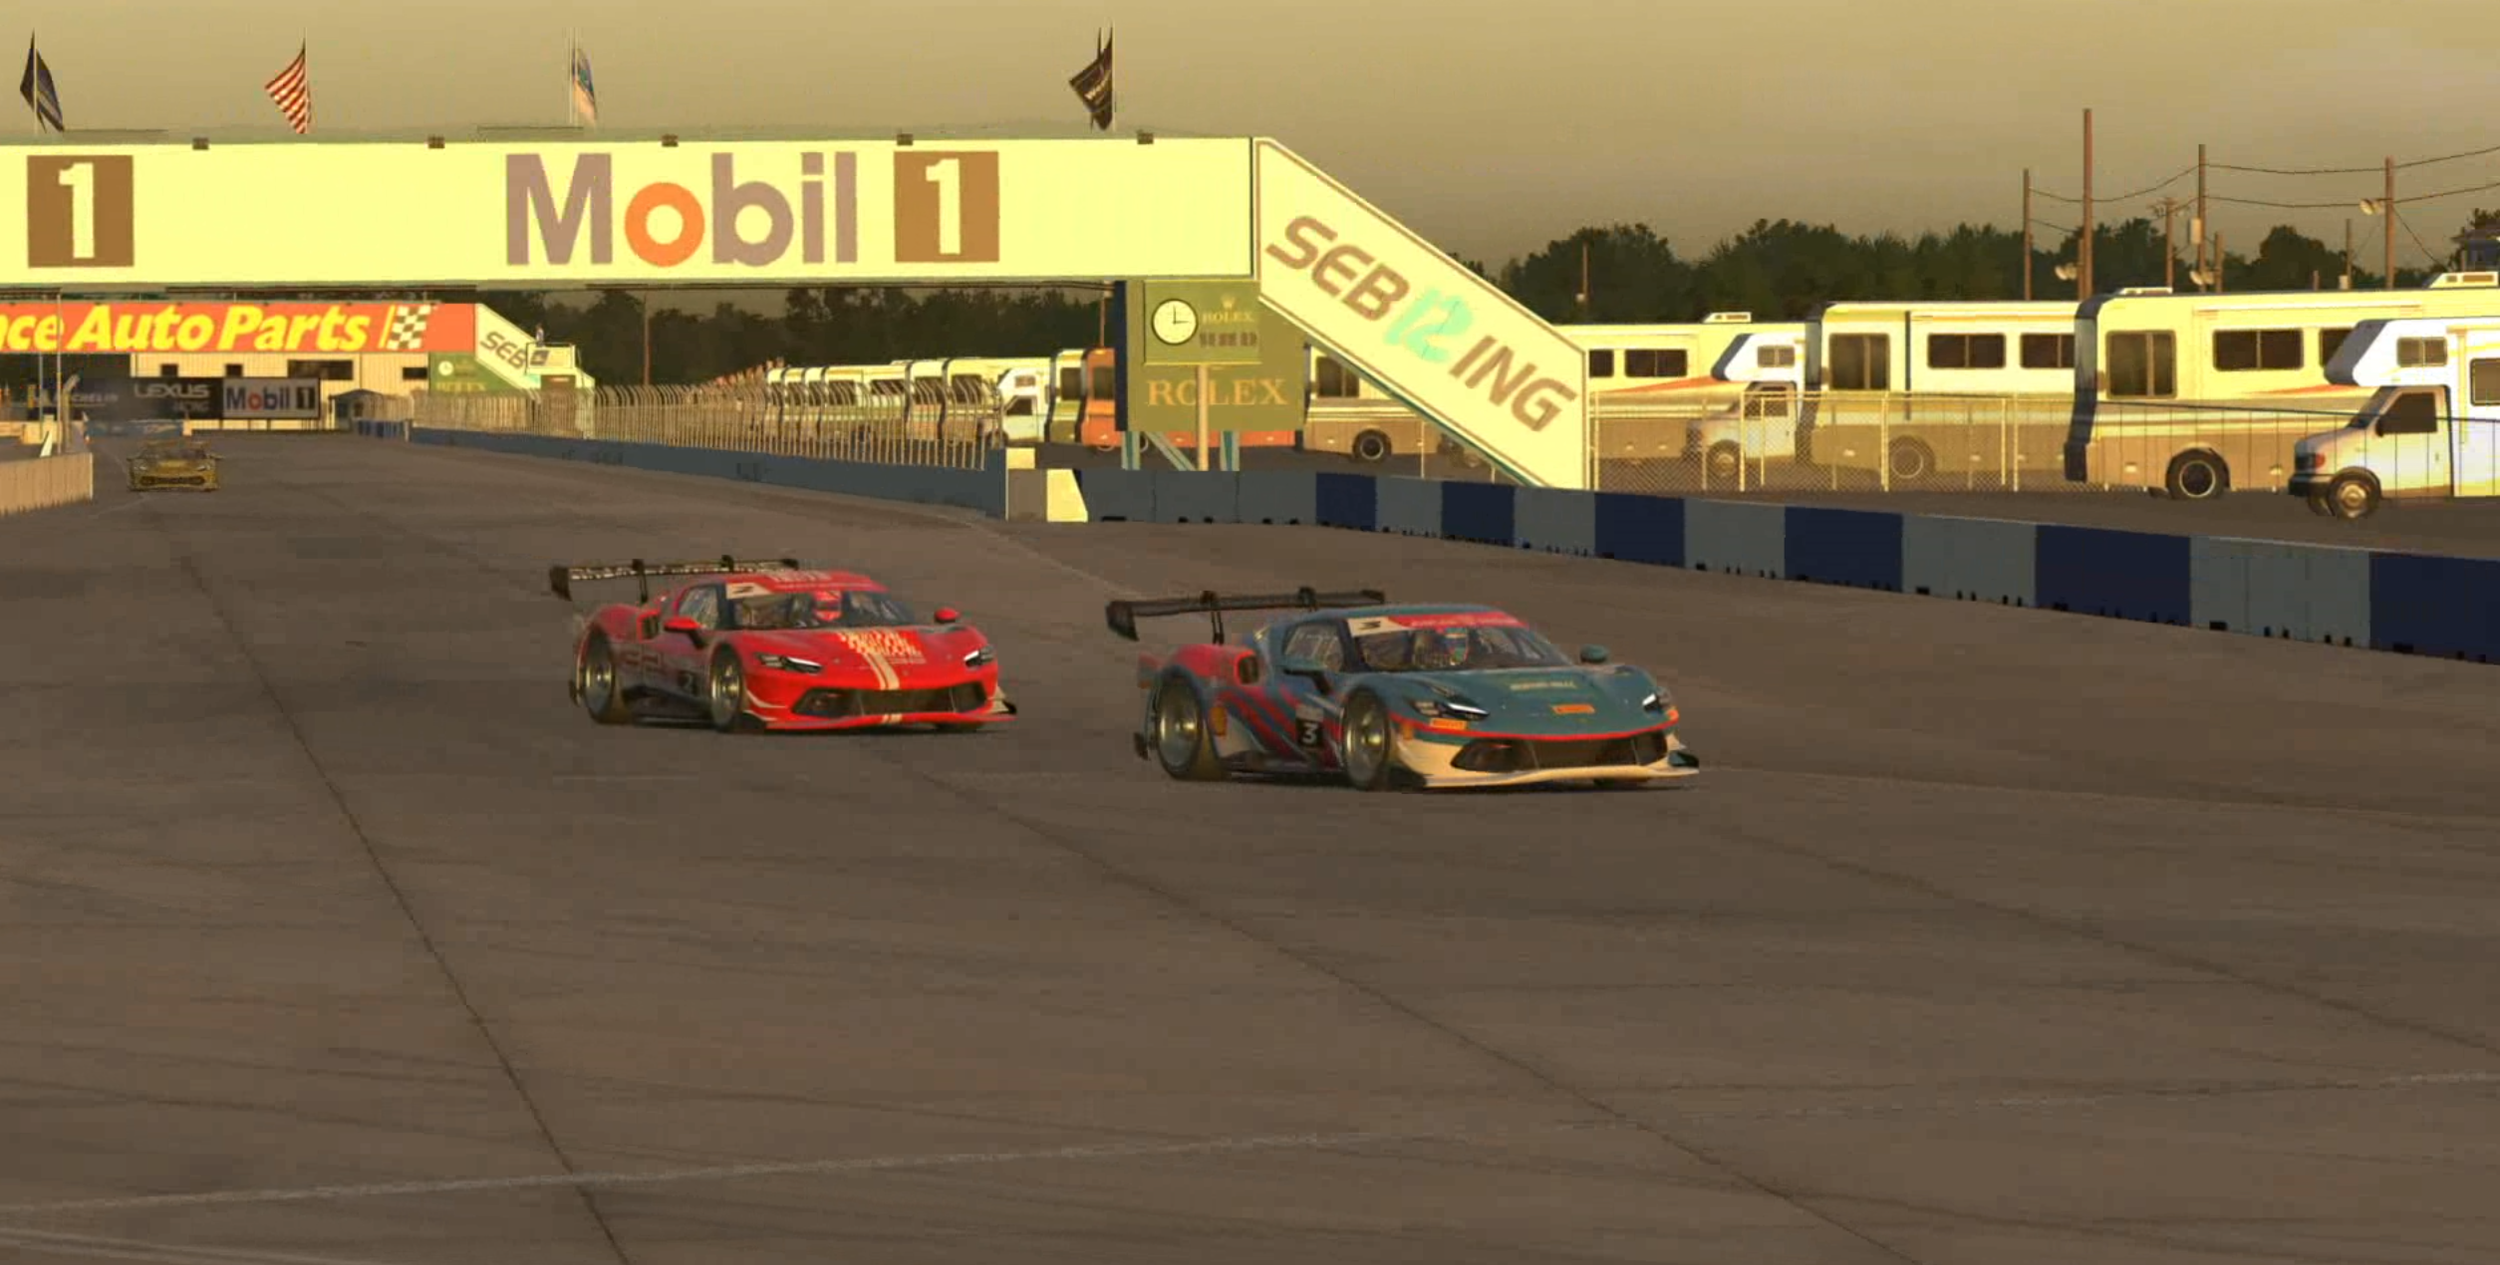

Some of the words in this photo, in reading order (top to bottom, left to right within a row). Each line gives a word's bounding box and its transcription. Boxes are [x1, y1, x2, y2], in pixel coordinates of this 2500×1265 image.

[59, 162, 95, 259] 1
[505, 152, 858, 267] Mobil
[925, 158, 961, 254] 1
[67, 304, 213, 350] Auto
[217, 304, 369, 350] Parts
[1202, 311, 1256, 325] ROLEX
[480, 331, 526, 368] SEB
[133, 384, 211, 398] LEXUS
[226, 387, 290, 411] Mobil
[1146, 378, 1289, 406] ROLEX
[1302, 722, 1318, 744] 3
